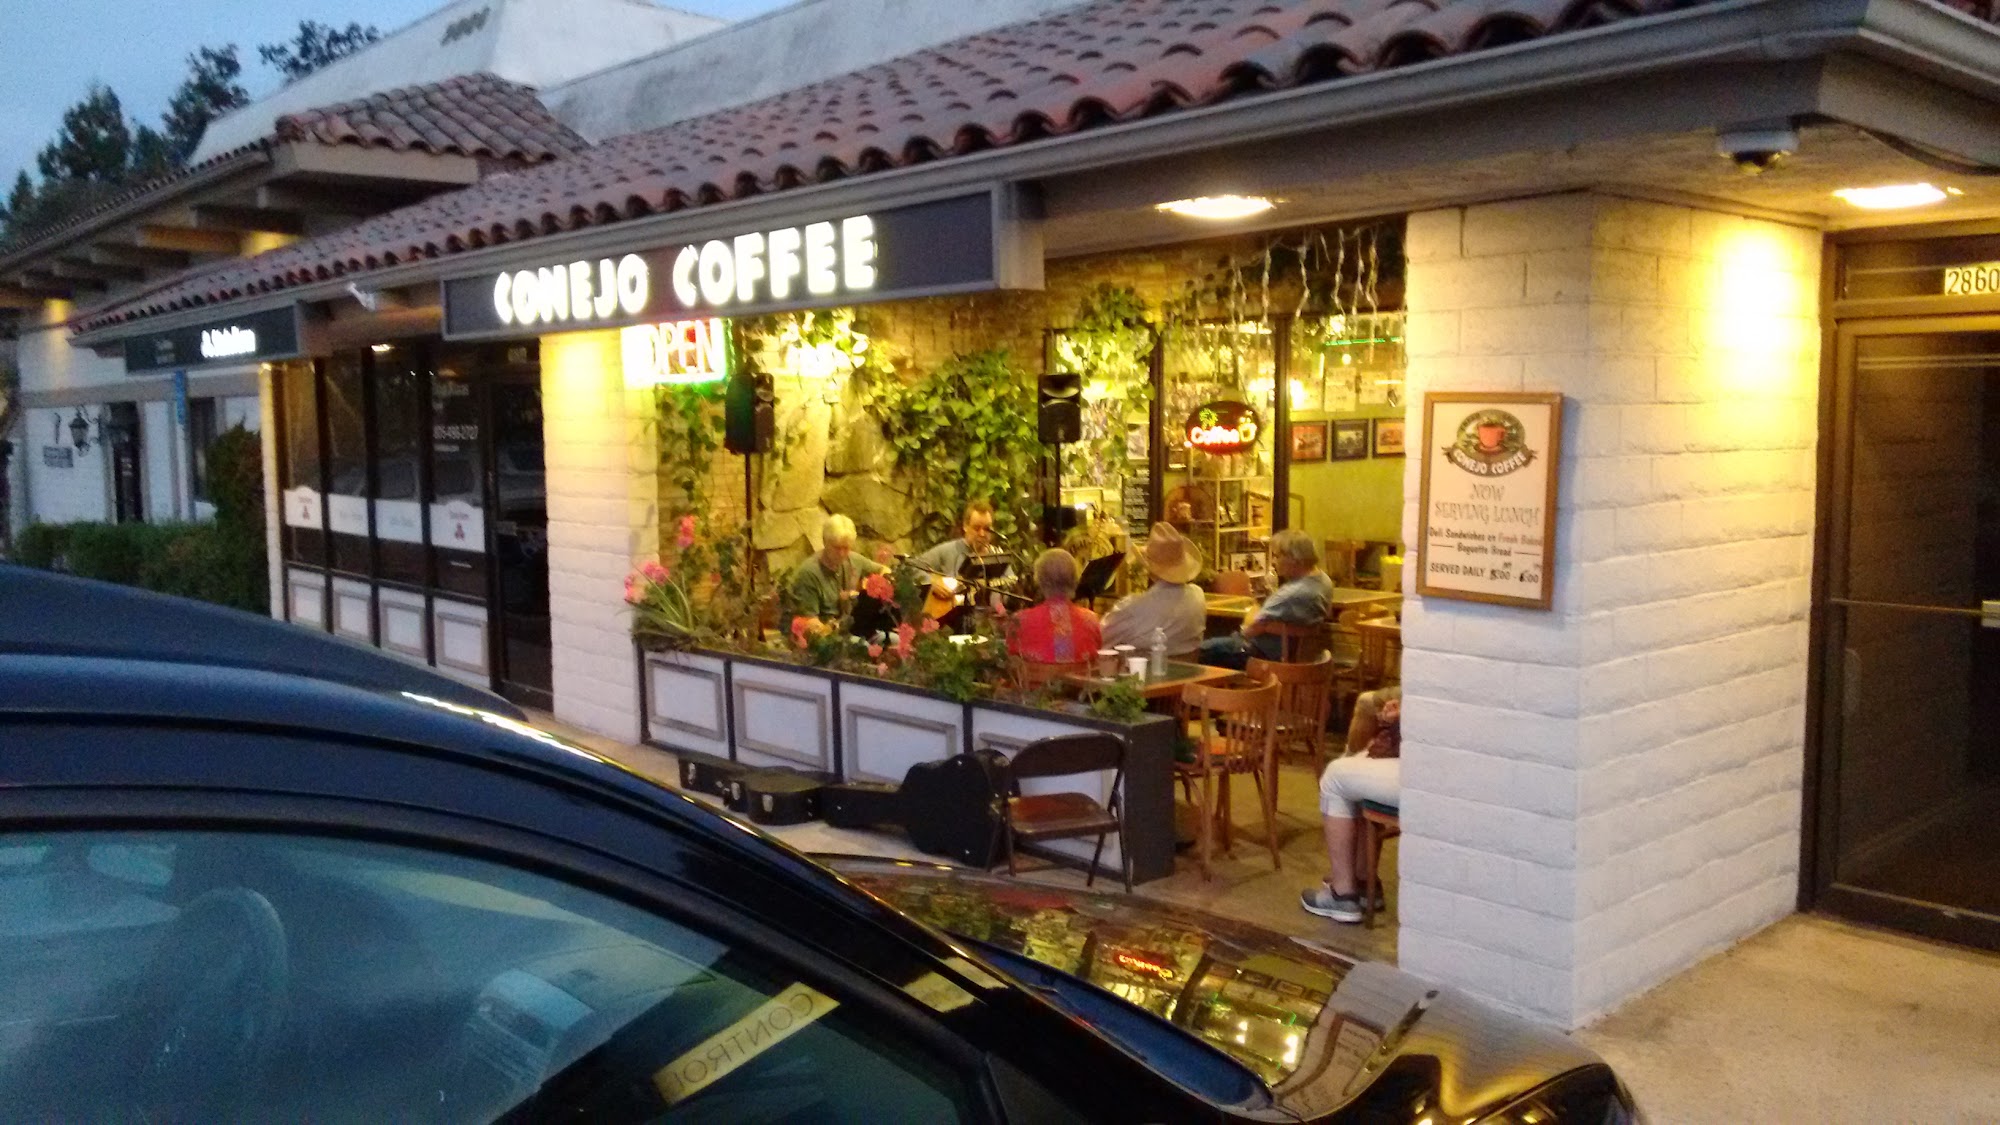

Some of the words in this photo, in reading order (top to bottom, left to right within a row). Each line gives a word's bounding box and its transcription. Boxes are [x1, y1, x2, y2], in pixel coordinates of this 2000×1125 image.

[494, 254, 649, 325] CONEJO
[672, 214, 876, 307] COFFEE
[1947, 265, 2000, 294] 2860
[644, 316, 719, 374] OPEN
[1453, 448, 1488, 474] CONEJO
[1491, 450, 1527, 475] COFFEE
[1469, 483, 1506, 501] NOW
[1434, 501, 1489, 524] SERVING
[1493, 505, 1540, 527] LUNCH
[1445, 528, 1485, 541] Sandwiches
[1430, 562, 1460, 575] SERVED
[1462, 565, 1486, 578] DAILY
